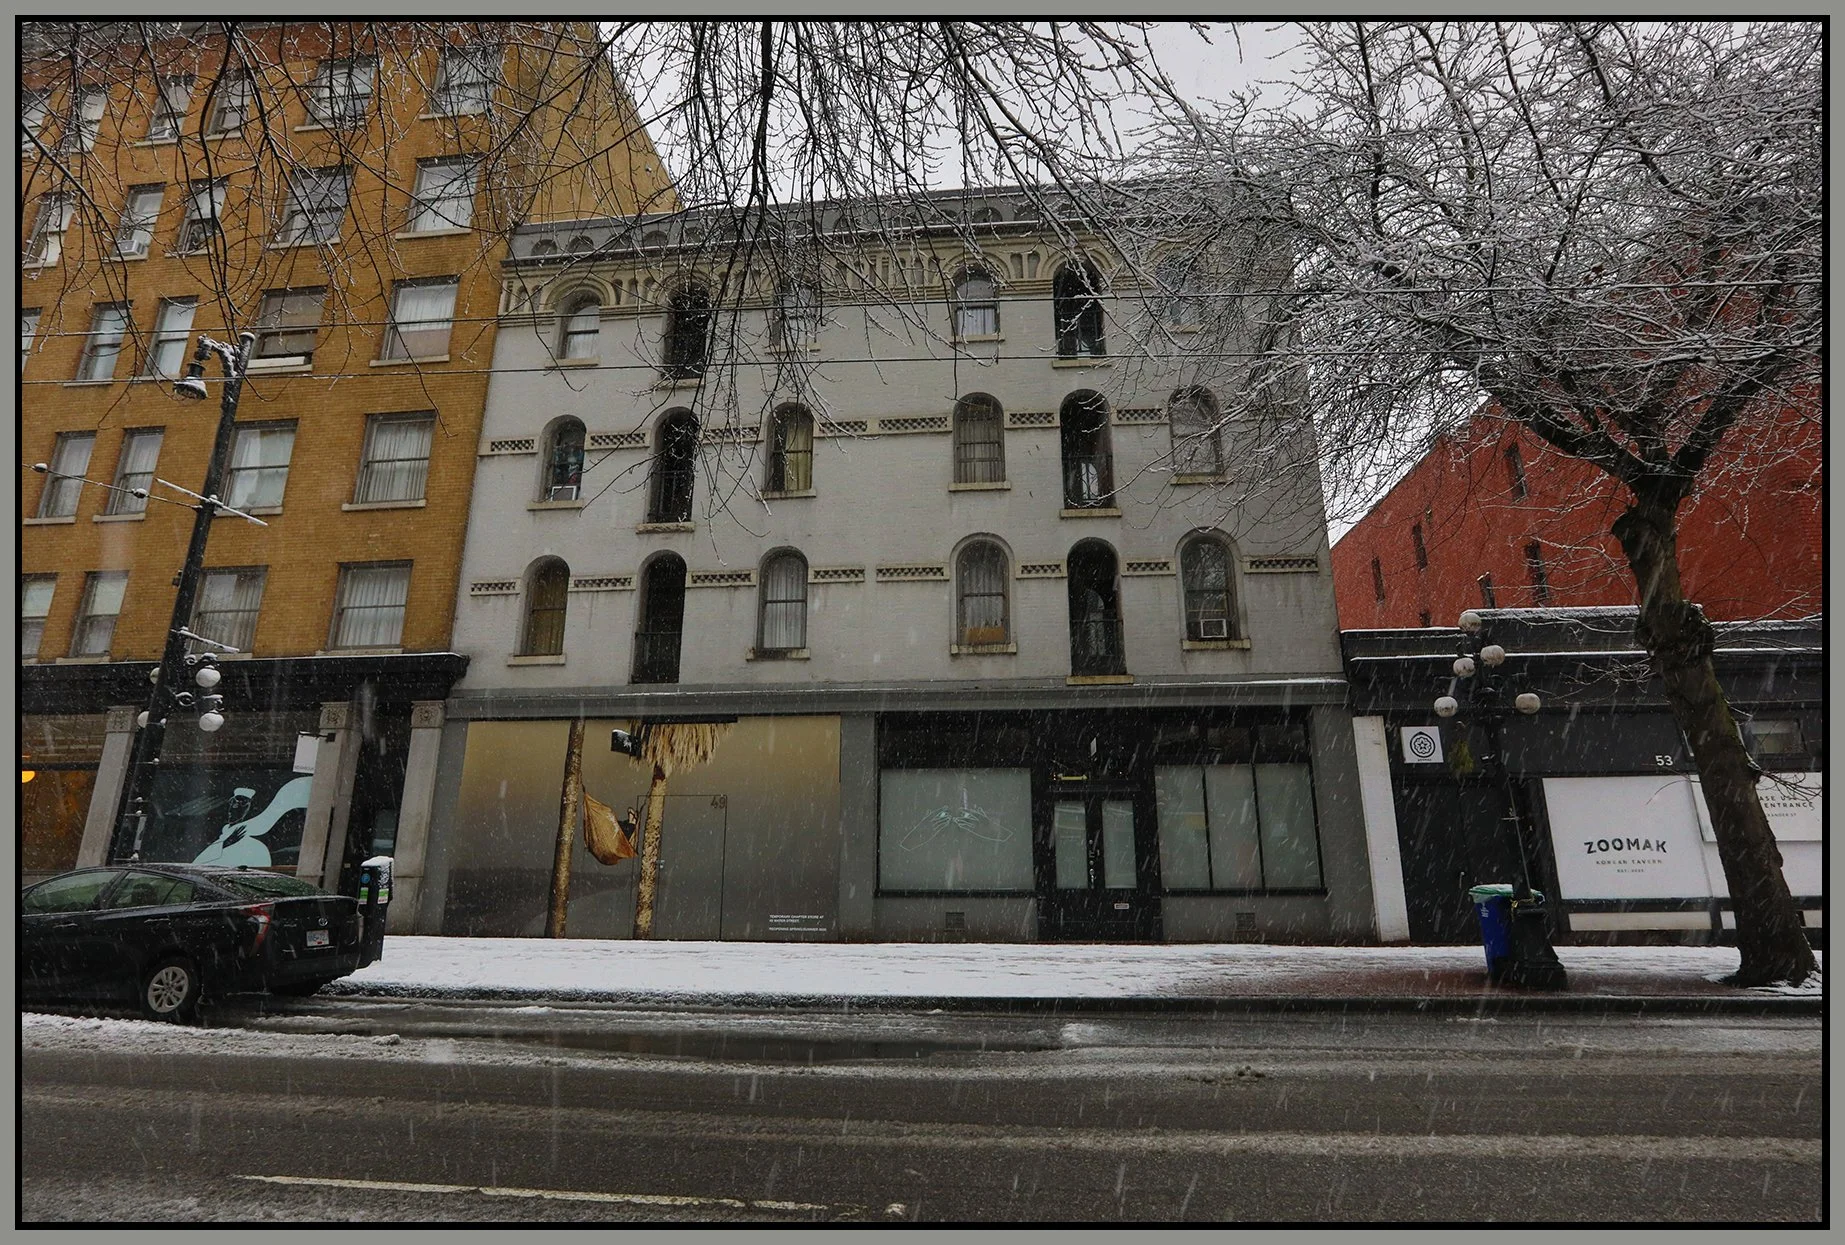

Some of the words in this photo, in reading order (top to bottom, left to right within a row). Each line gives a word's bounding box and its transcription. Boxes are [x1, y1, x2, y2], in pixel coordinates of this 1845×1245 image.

[1655, 755, 1673, 766] 53
[710, 796, 725, 809] 49
[1584, 838, 1667, 854] ZOOMAK
